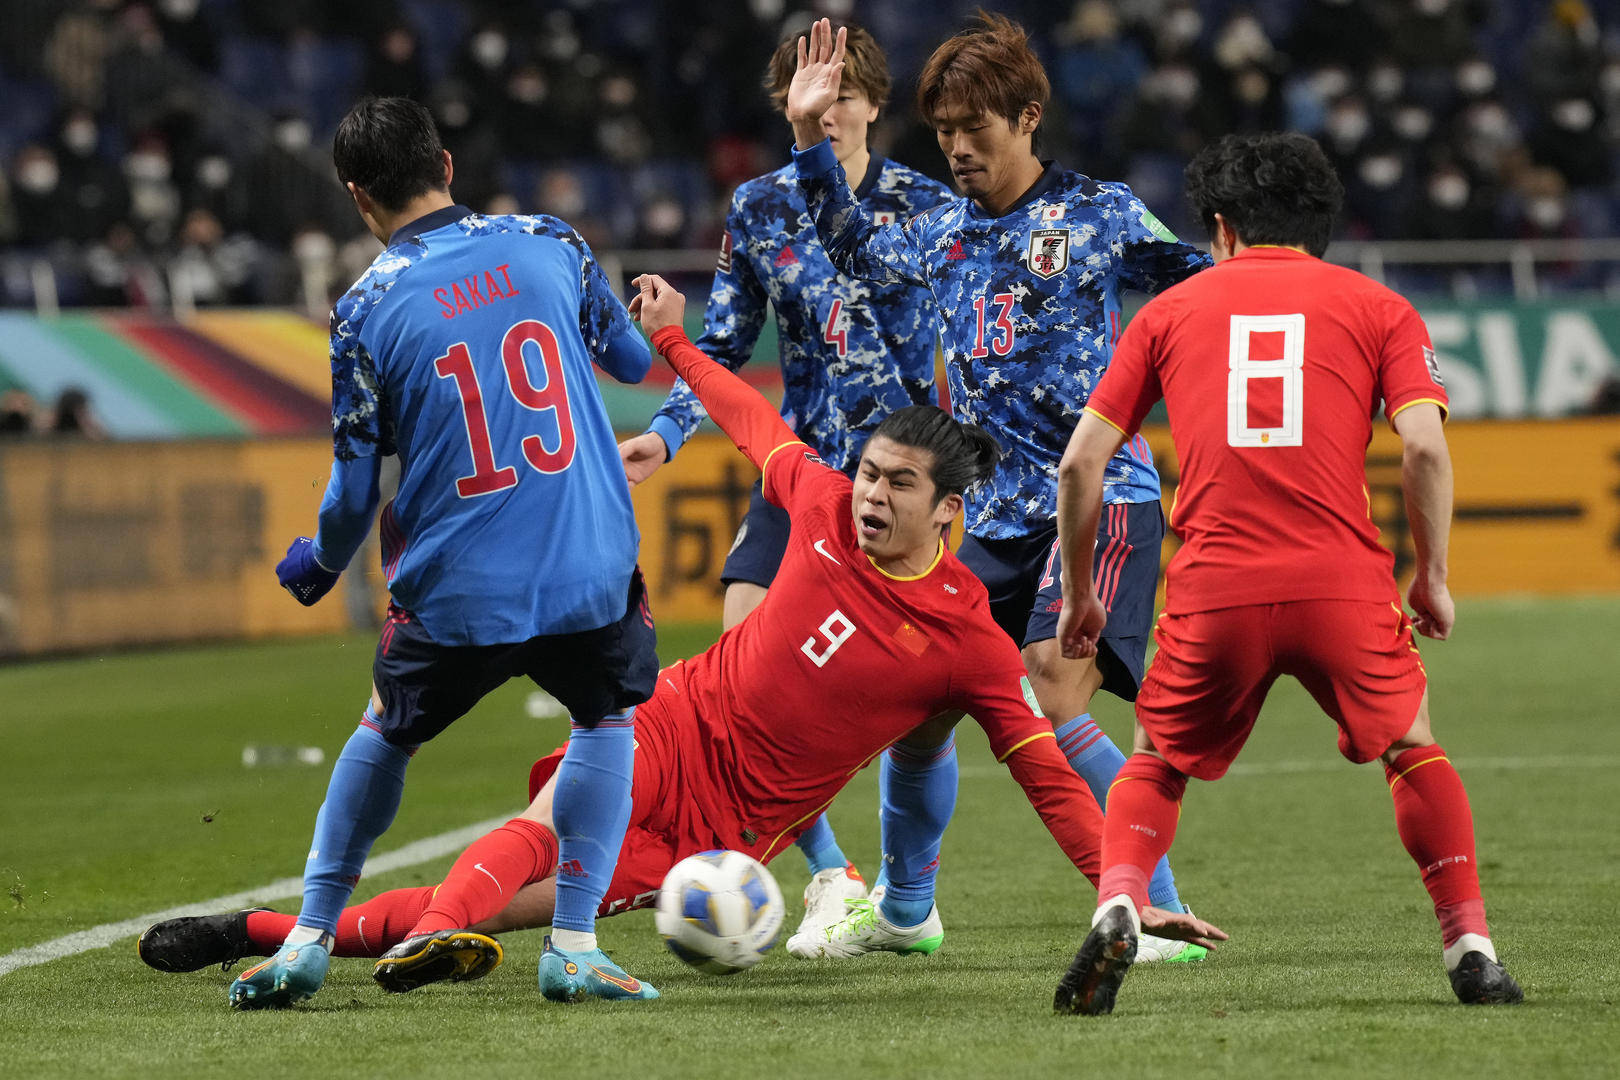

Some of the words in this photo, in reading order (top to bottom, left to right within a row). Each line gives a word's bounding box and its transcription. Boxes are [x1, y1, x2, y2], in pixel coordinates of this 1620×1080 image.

[433, 264, 519, 319] SAKAI
[1038, 263, 1056, 271] JFA
[824, 299, 848, 358] 4
[971, 293, 1015, 359] 13
[1227, 313, 1306, 447] 8
[1424, 312, 1616, 417] SIA
[433, 318, 577, 499] 19
[800, 609, 857, 668] 9
[1427, 855, 1468, 873] CFA
